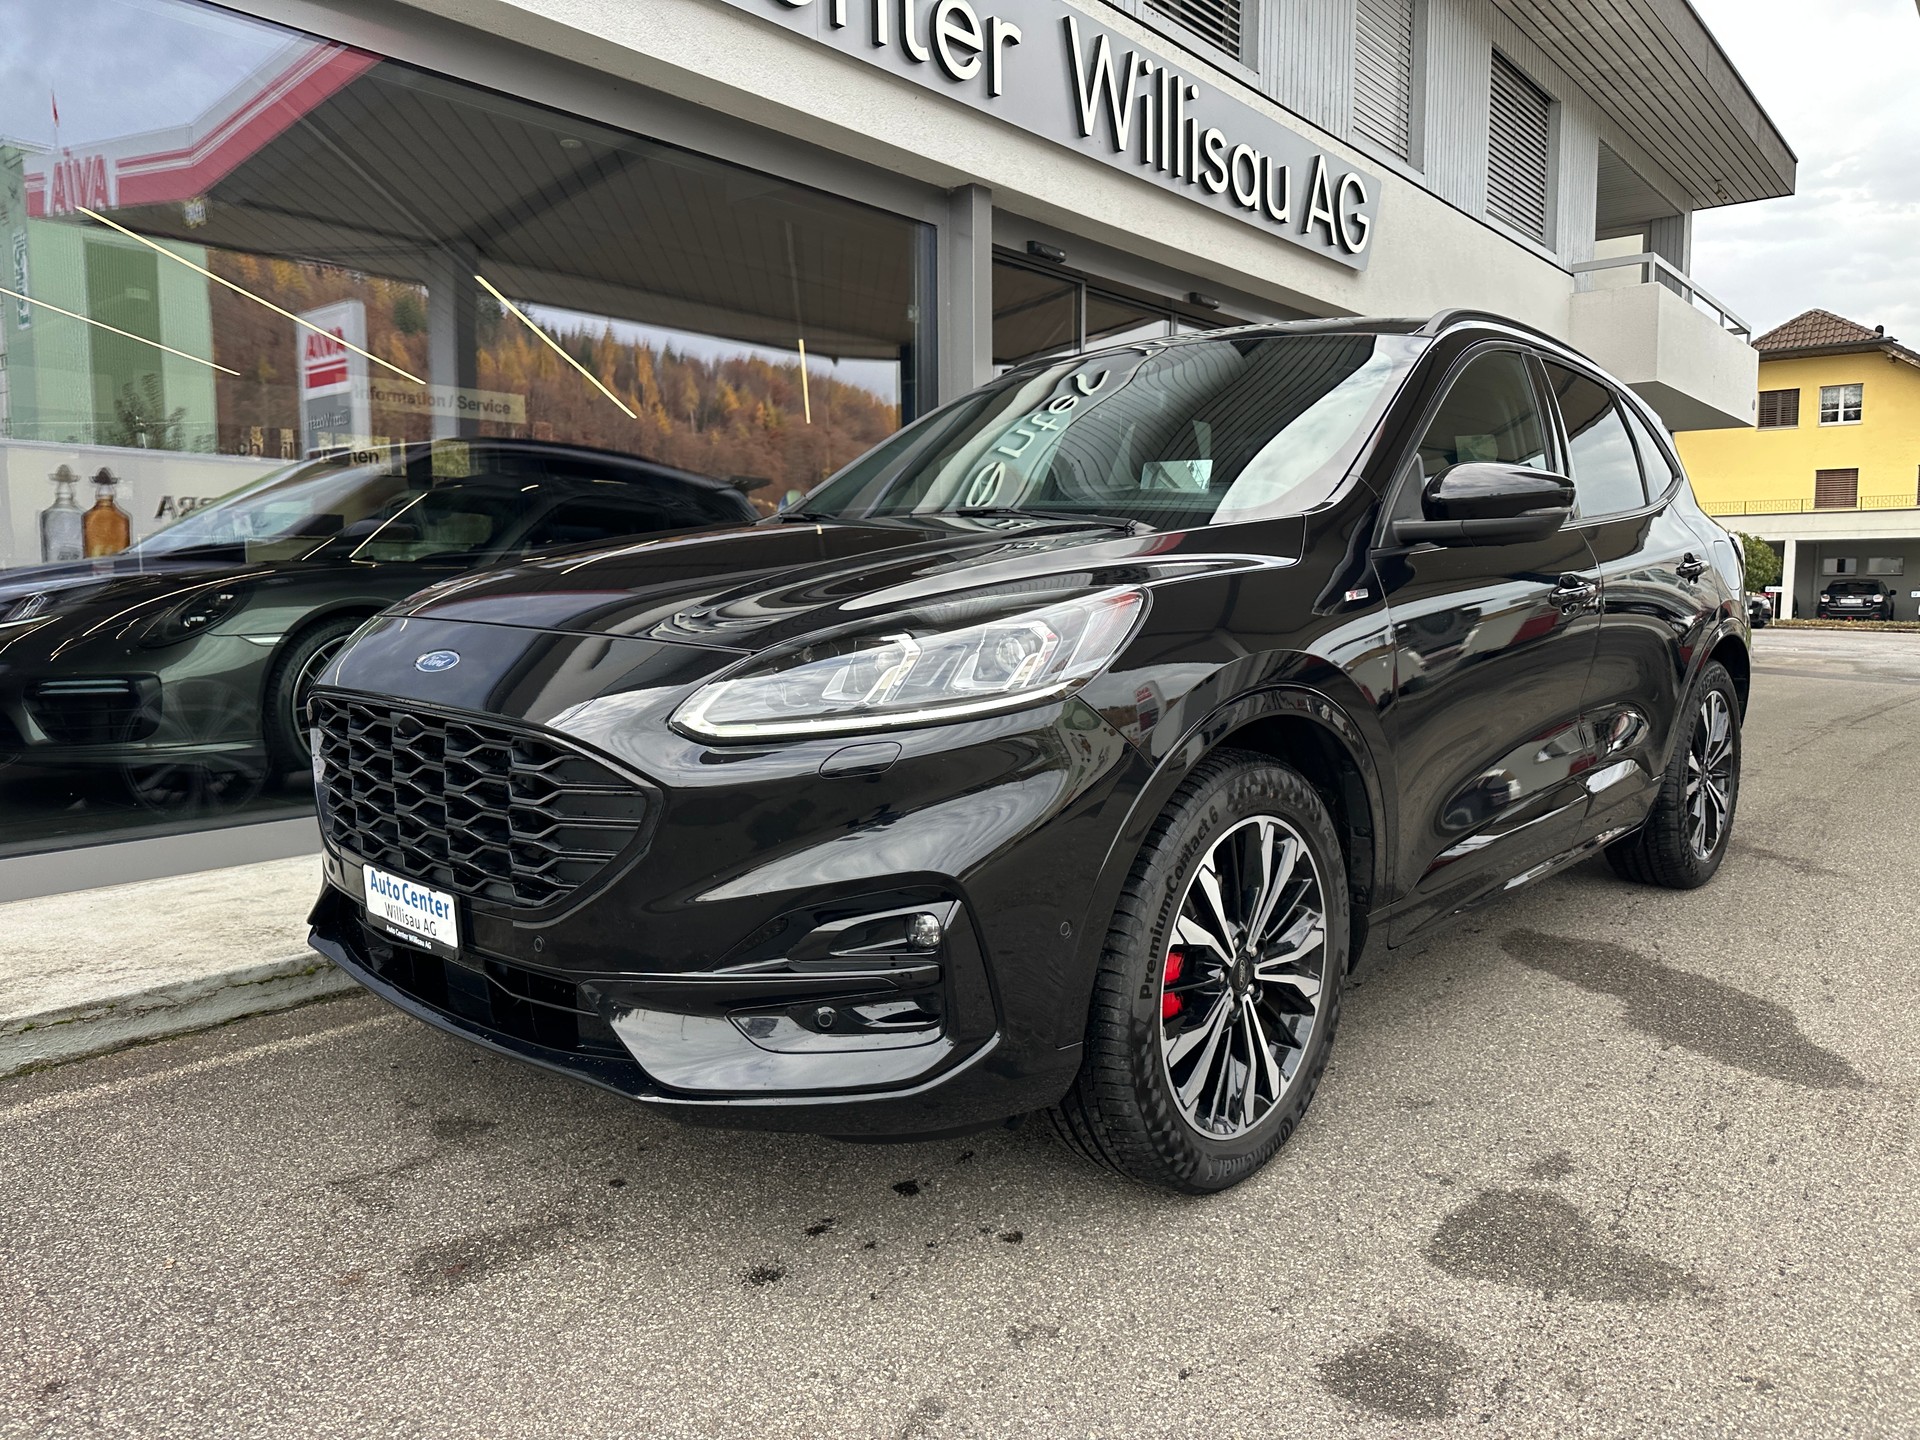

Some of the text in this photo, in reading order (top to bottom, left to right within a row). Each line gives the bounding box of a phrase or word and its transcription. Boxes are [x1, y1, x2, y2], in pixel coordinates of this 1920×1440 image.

[1064, 16, 1292, 224] Willisau
[1301, 154, 1371, 254] AG
[457, 395, 511, 415] Service
[384, 901, 437, 937] Willisau AG
[1139, 805, 1219, 1000] PremiumContact 6
